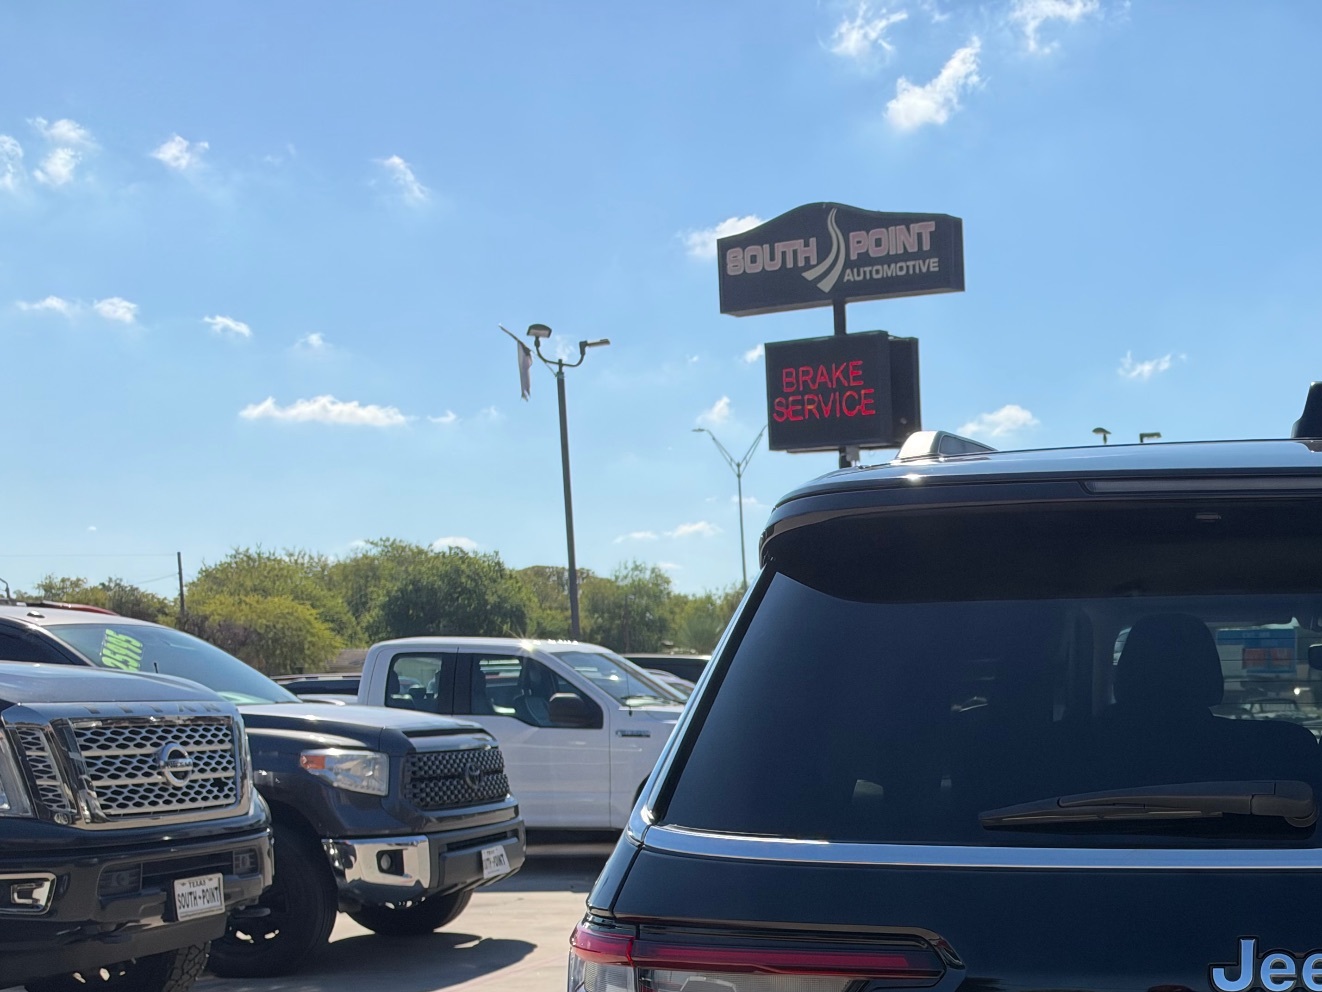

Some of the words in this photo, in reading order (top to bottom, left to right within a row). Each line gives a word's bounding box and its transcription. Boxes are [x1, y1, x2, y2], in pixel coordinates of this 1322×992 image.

[726, 237, 817, 276] SOUTH
[849, 221, 935, 260] POINT
[843, 257, 939, 283] AUTOMOTIVE
[782, 360, 864, 393] BRAKE
[773, 388, 876, 422] SERVICE
[177, 890, 199, 910] SOUTH
